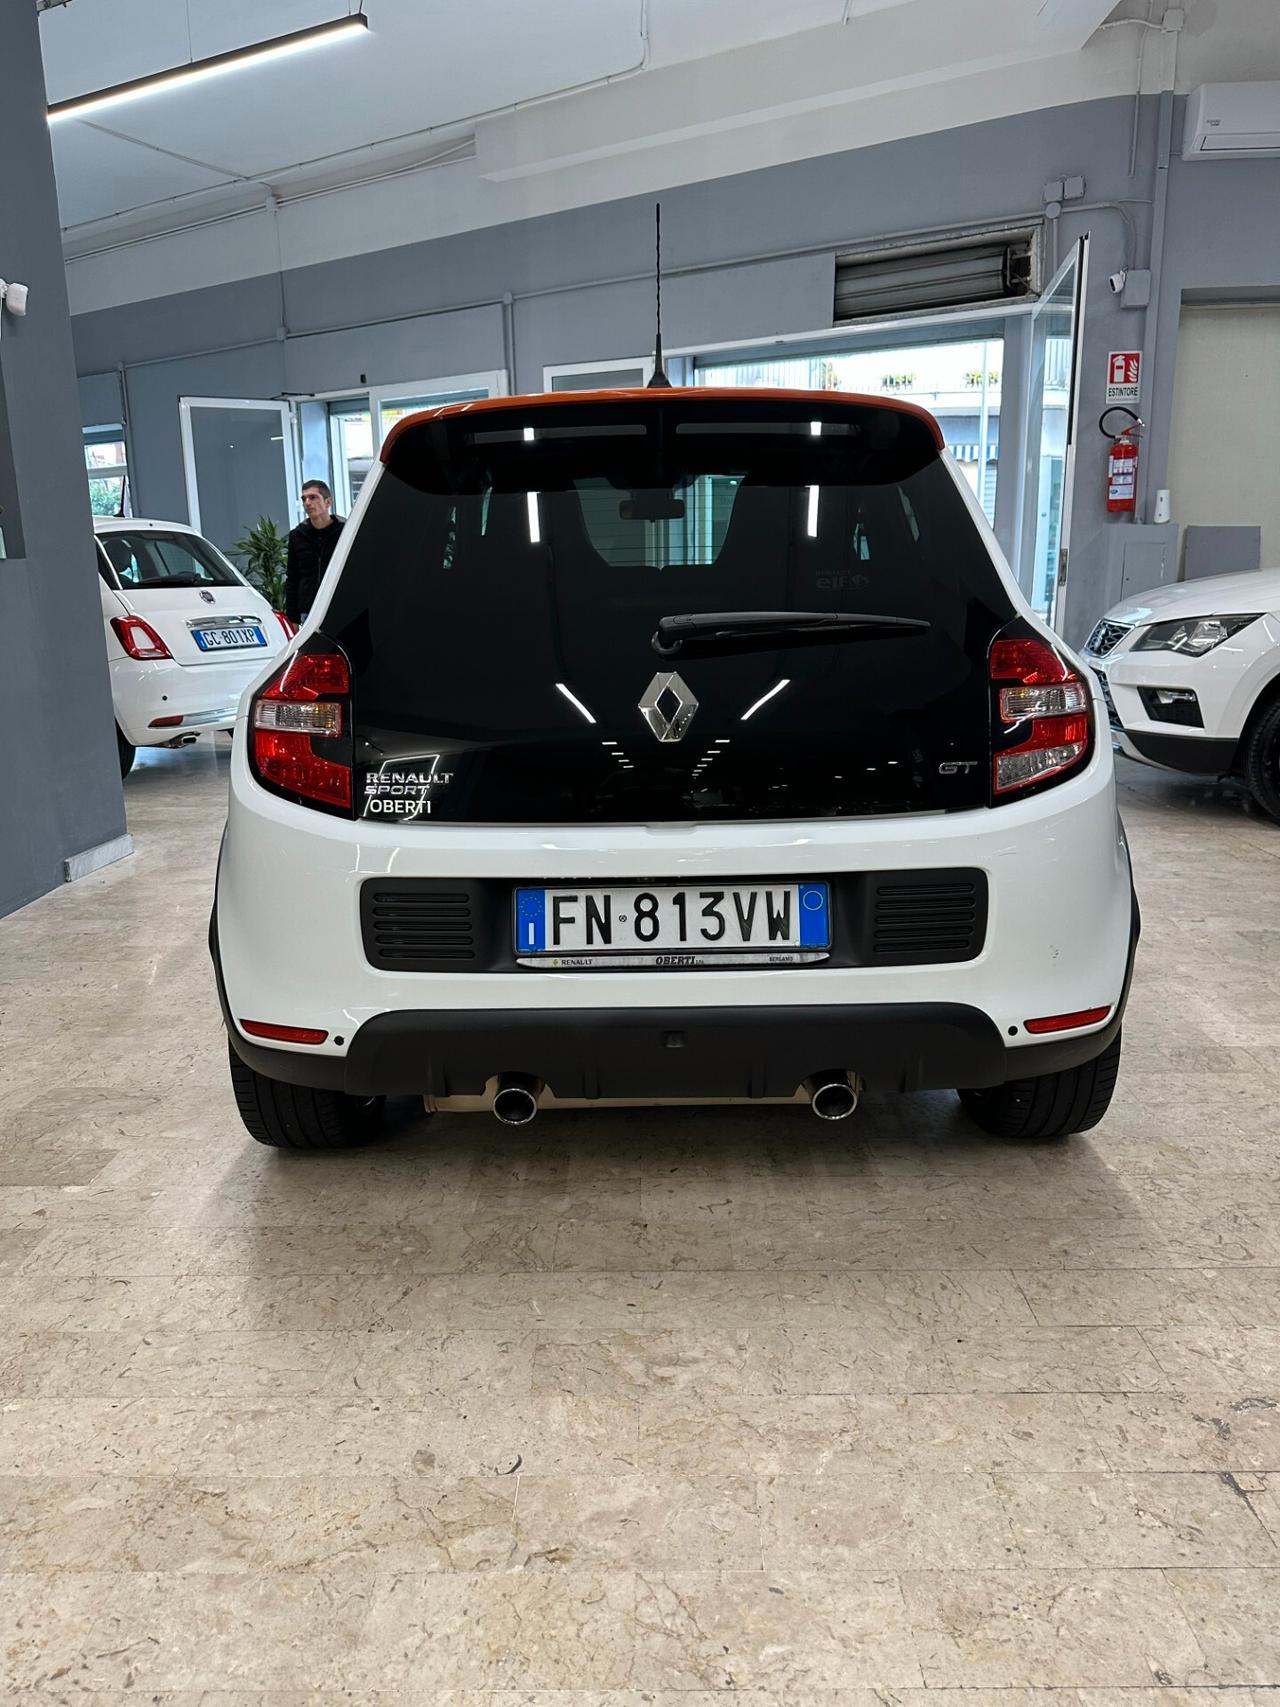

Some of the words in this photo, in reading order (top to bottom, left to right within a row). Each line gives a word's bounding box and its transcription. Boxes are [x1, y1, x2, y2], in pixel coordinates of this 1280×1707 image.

[1108, 387, 1138, 397] ESTINTORE
[939, 761, 978, 774] GT
[366, 772, 454, 783] RENAULT
[364, 784, 430, 795] SPORT
[369, 799, 432, 813] OBERTI
[655, 956, 696, 966] OBERTI
